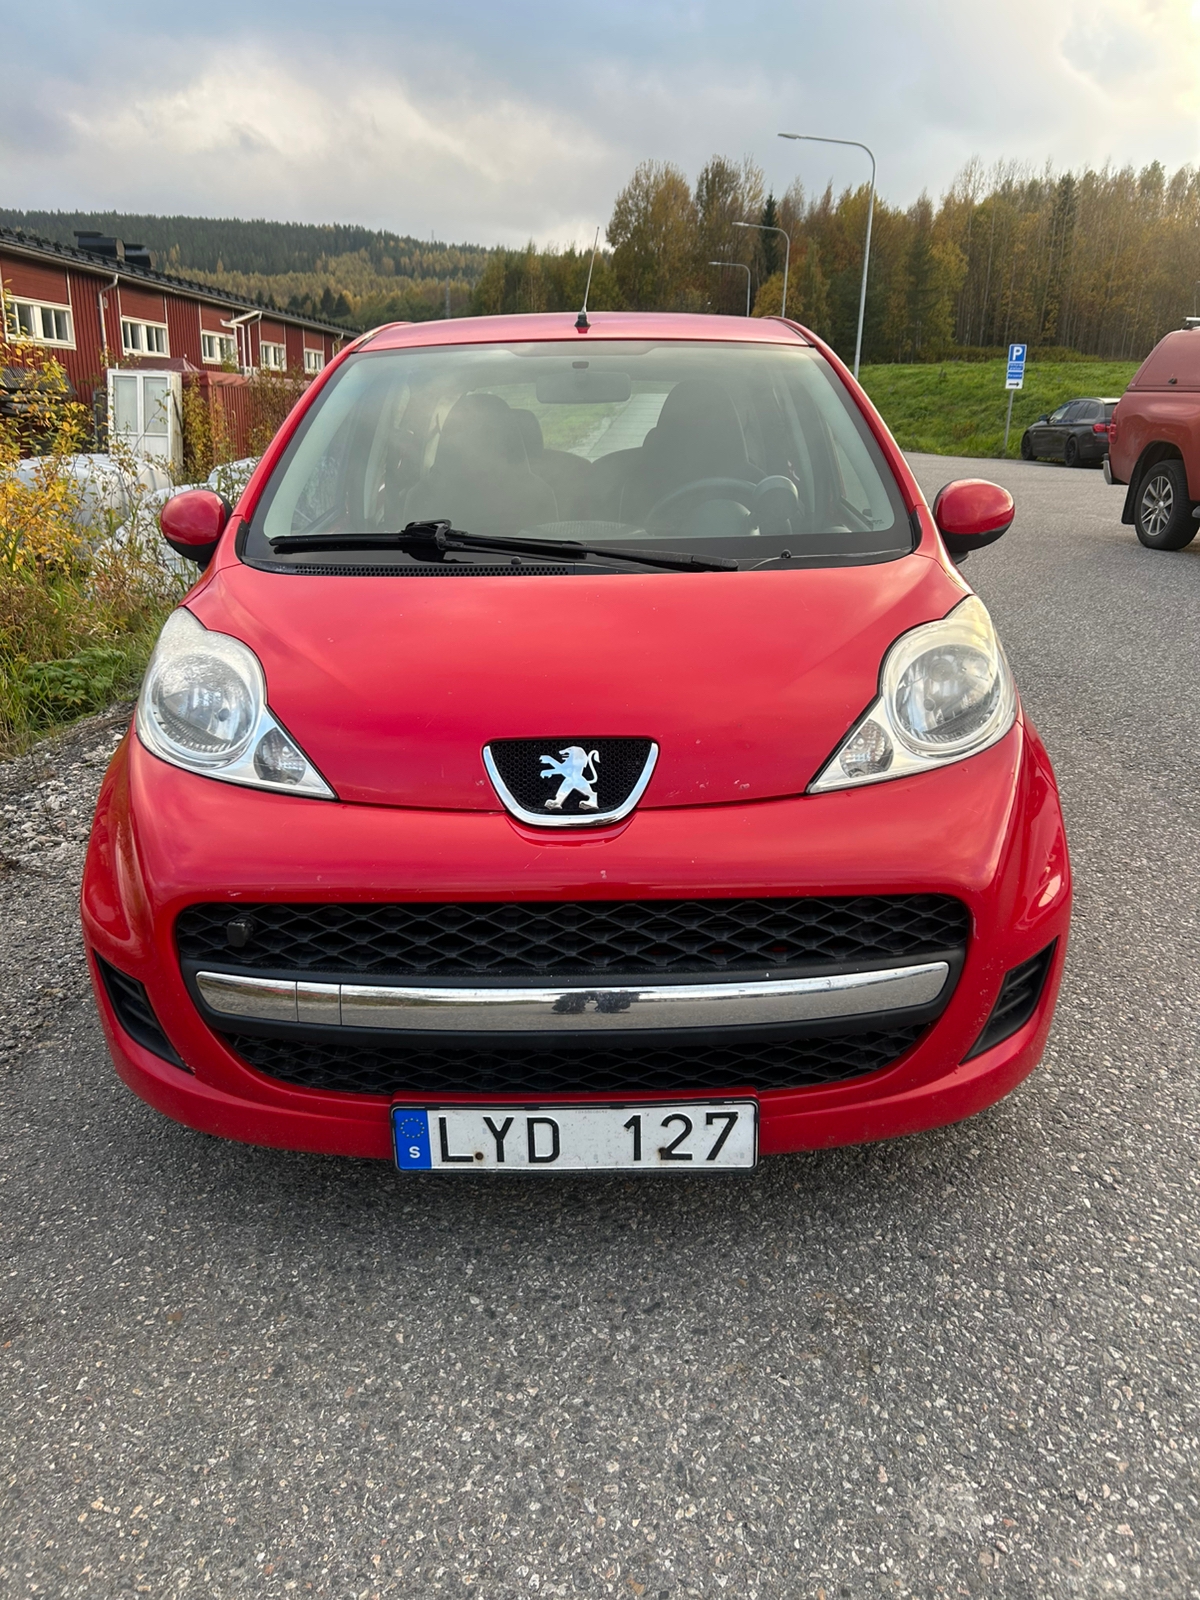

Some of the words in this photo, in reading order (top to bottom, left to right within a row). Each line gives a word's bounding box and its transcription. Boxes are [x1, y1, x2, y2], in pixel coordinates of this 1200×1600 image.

[1012, 346, 1023, 361] P
[438, 1116, 560, 1163] LYD
[623, 1111, 739, 1161] 127
[408, 1145, 421, 1159] S
